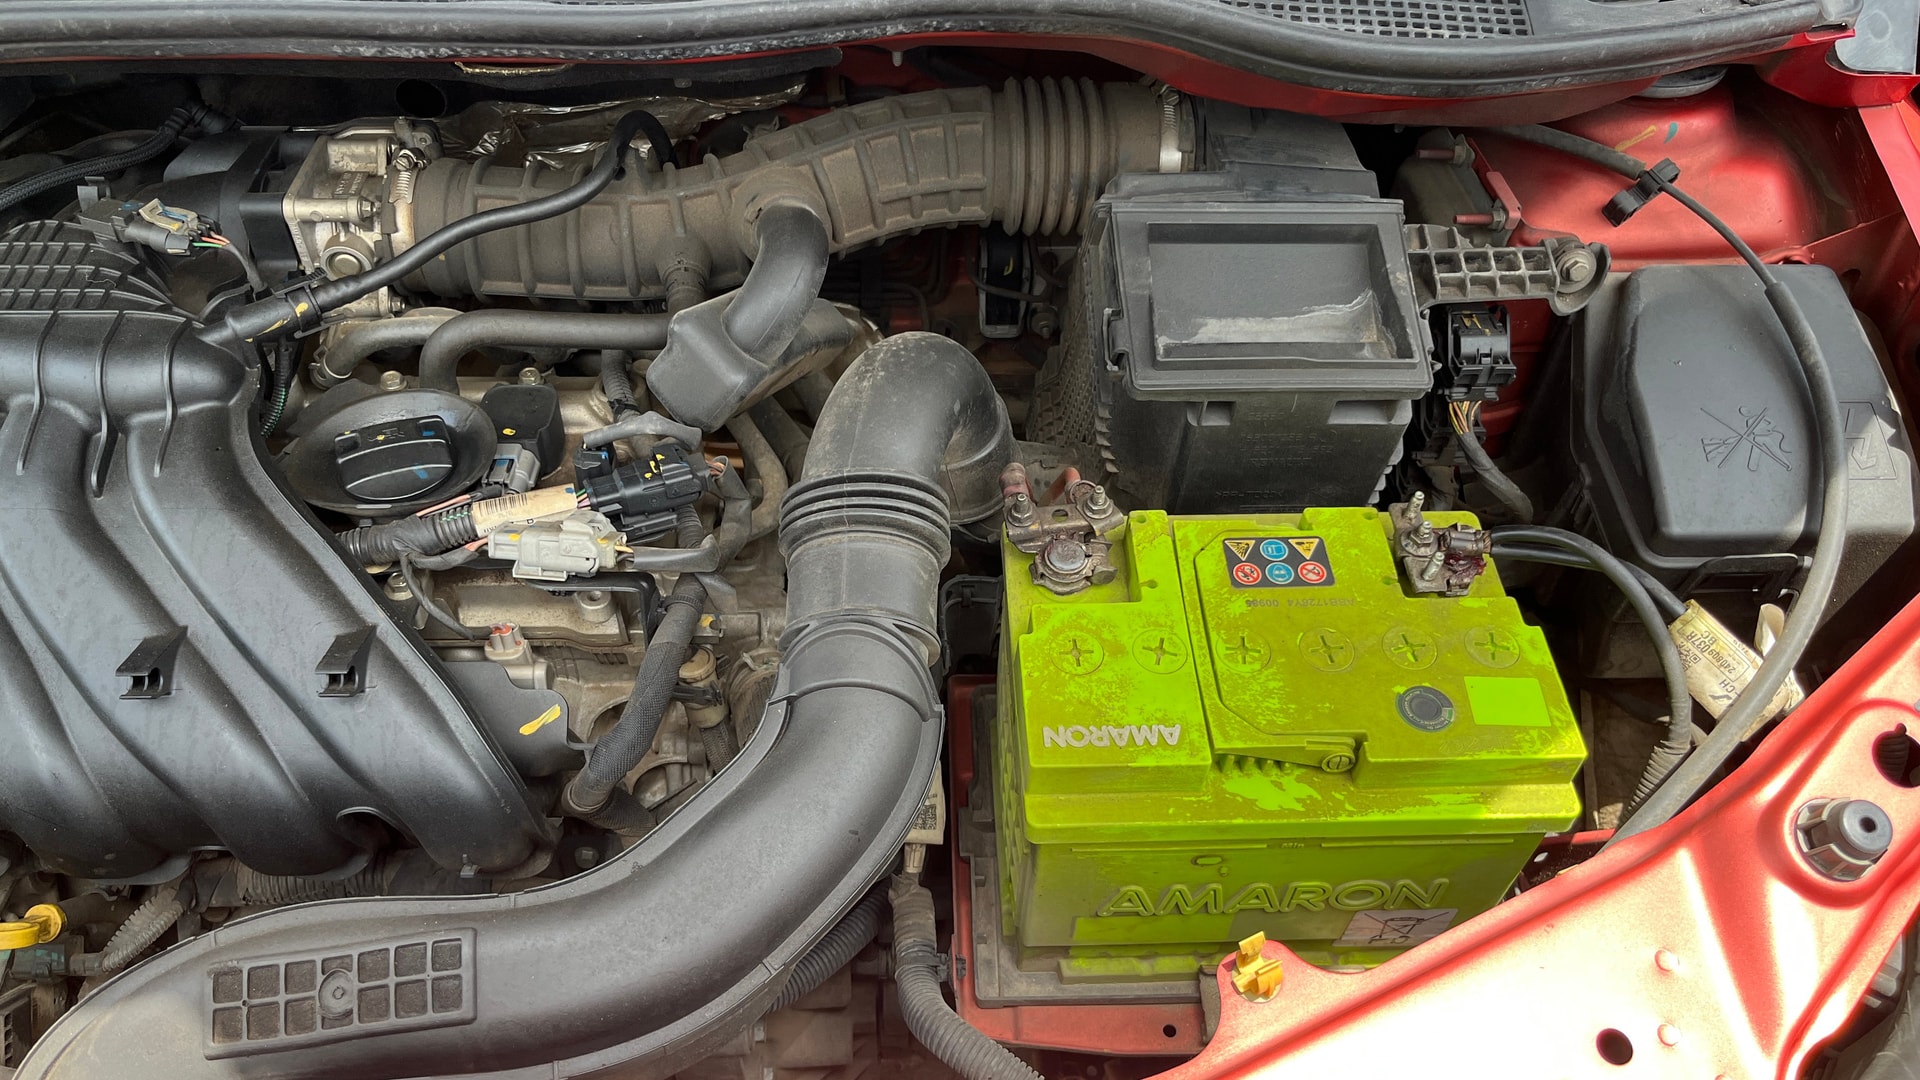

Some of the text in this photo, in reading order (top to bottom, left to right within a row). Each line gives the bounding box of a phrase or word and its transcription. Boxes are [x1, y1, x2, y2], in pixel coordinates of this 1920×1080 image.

[1701, 630, 1719, 646] BC
[1043, 724, 1182, 748] AMARON
[1096, 878, 1451, 917] AMARON
